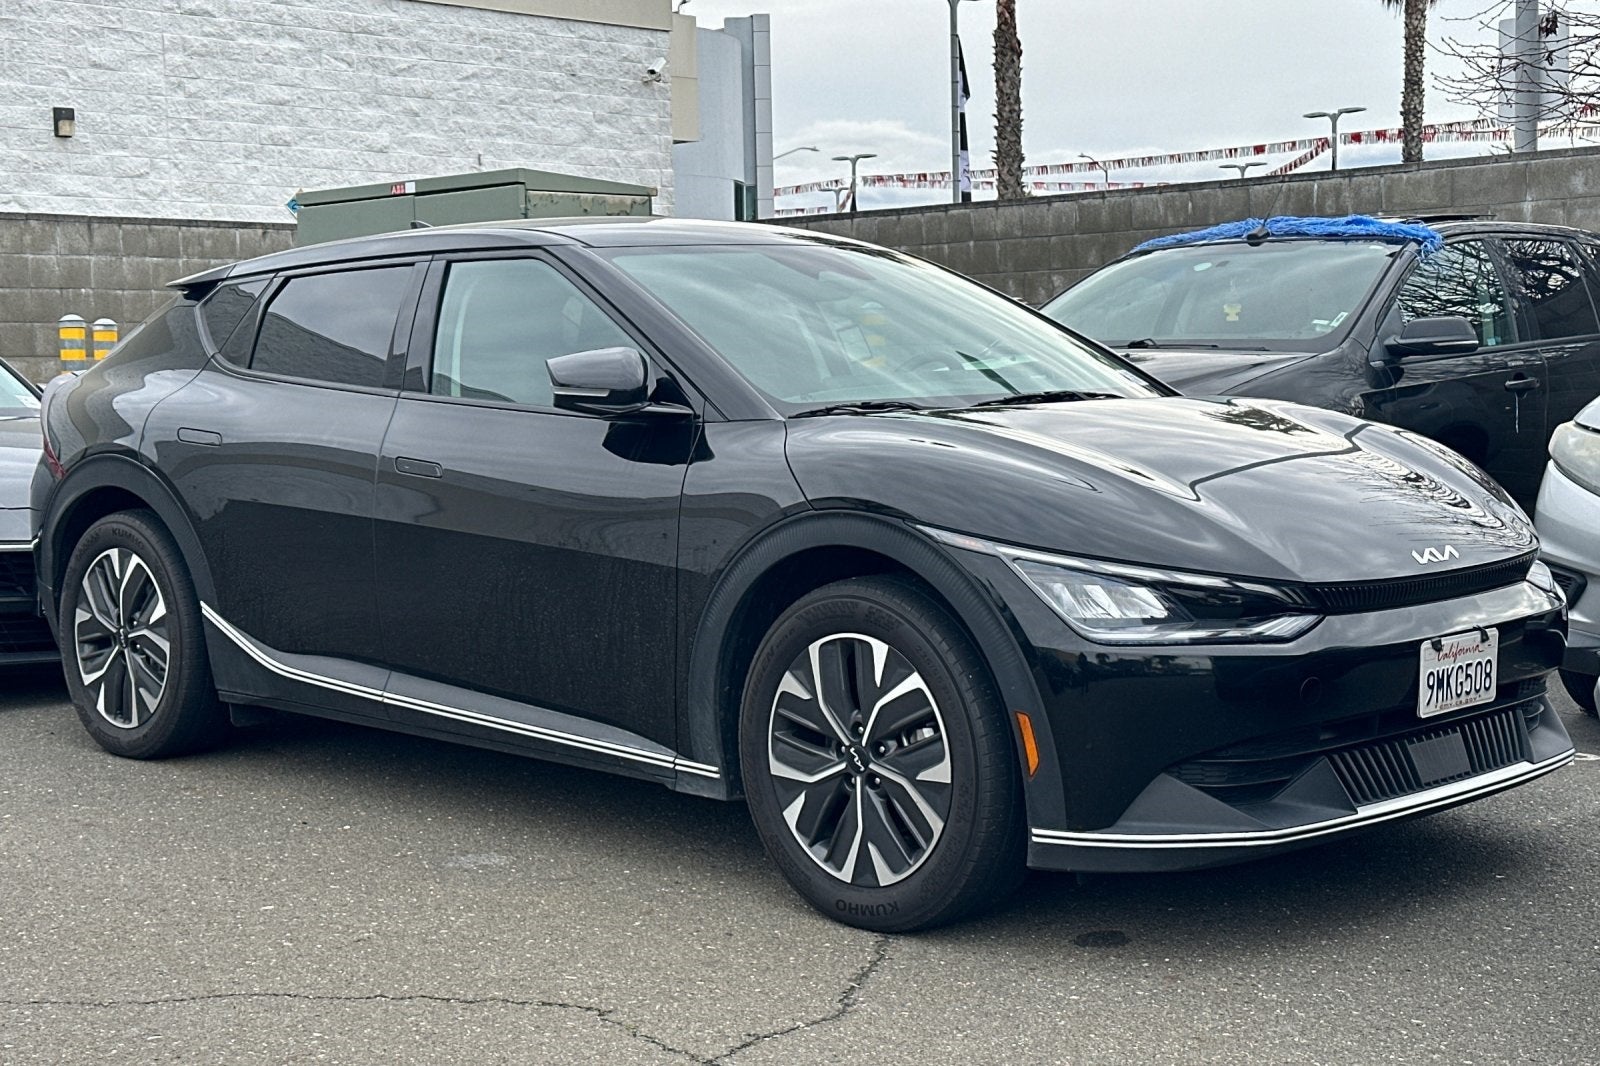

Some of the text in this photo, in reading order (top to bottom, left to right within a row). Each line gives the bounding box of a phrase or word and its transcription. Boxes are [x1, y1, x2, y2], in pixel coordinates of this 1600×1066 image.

[1411, 544, 1460, 565] KIA
[1425, 658, 1493, 706] 9MKG508
[835, 898, 900, 916] KUMHO
